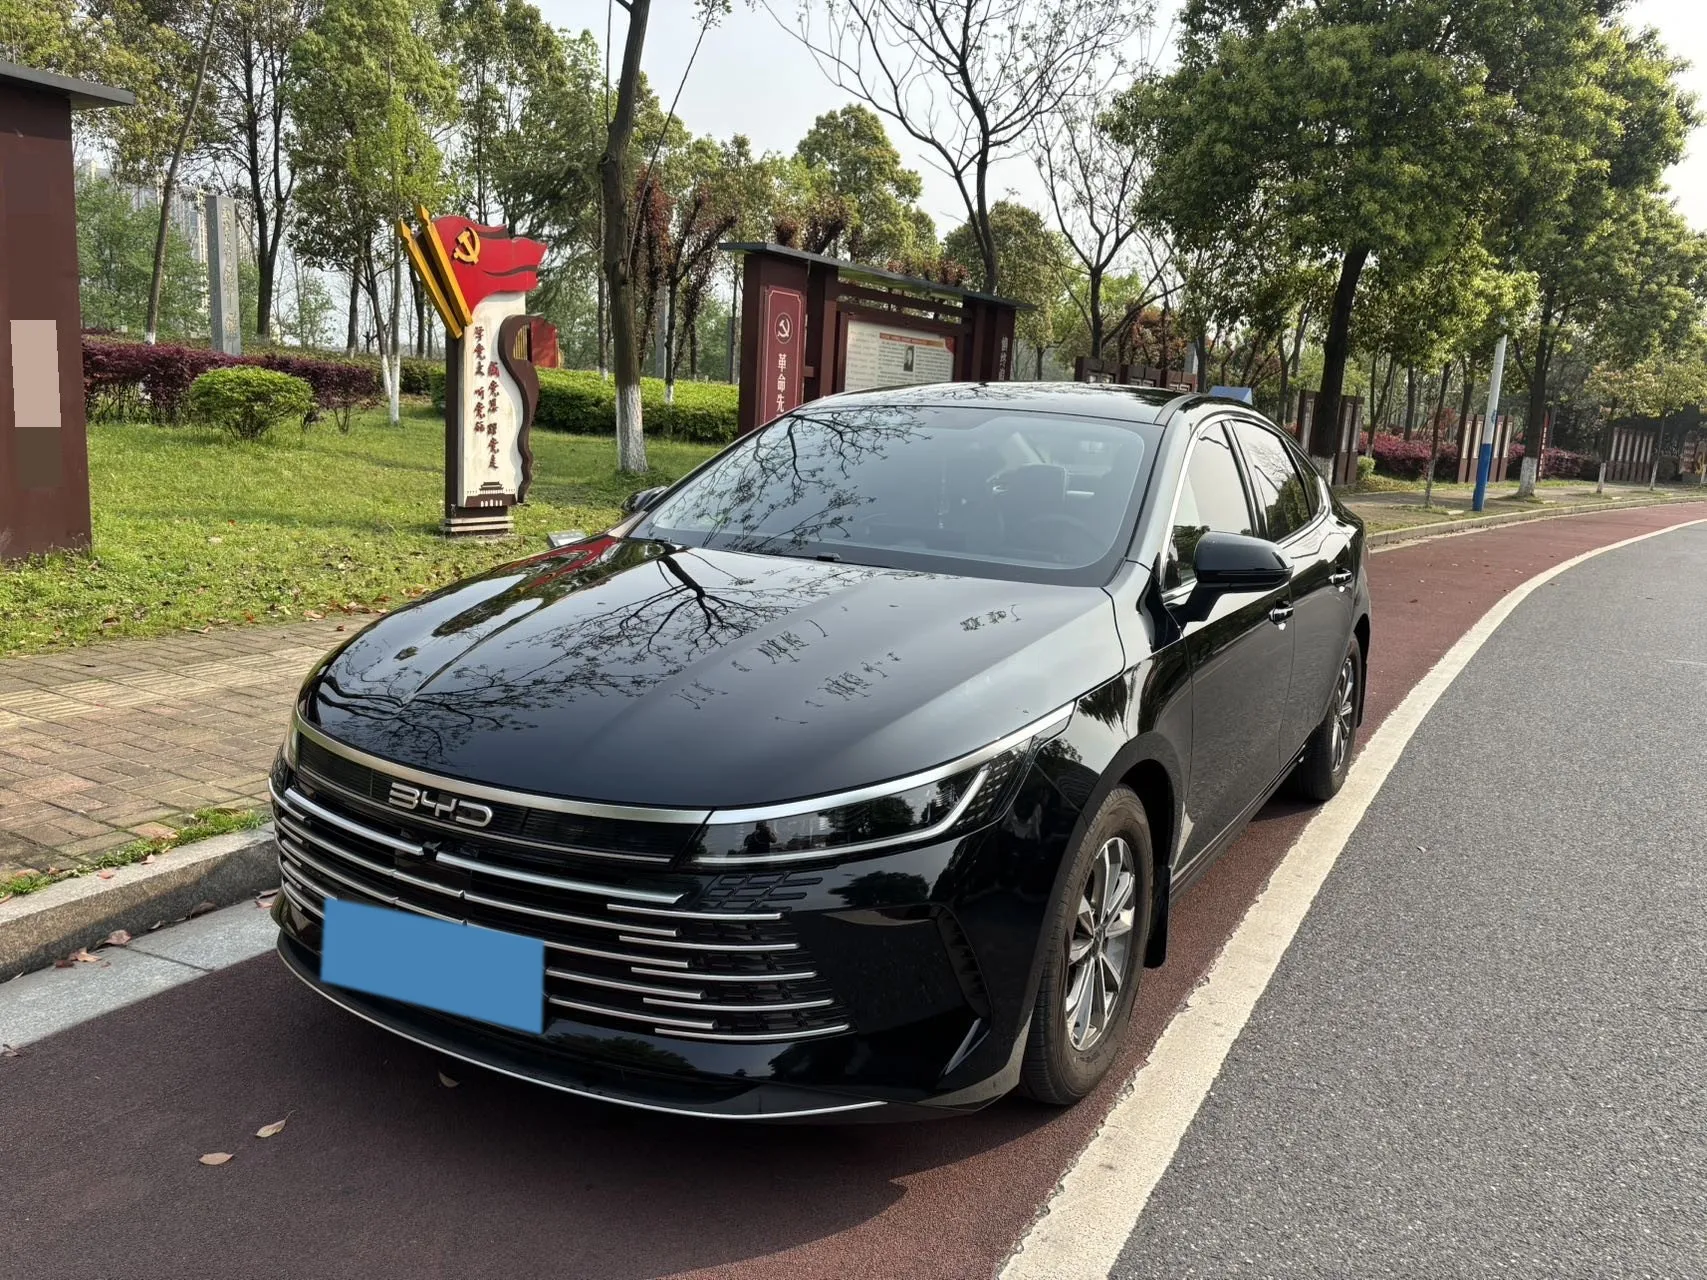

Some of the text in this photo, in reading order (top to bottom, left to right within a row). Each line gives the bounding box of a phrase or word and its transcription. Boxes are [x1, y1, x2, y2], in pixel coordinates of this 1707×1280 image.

[776, 353, 787, 417] 革命先
[388, 782, 493, 827] BYD
